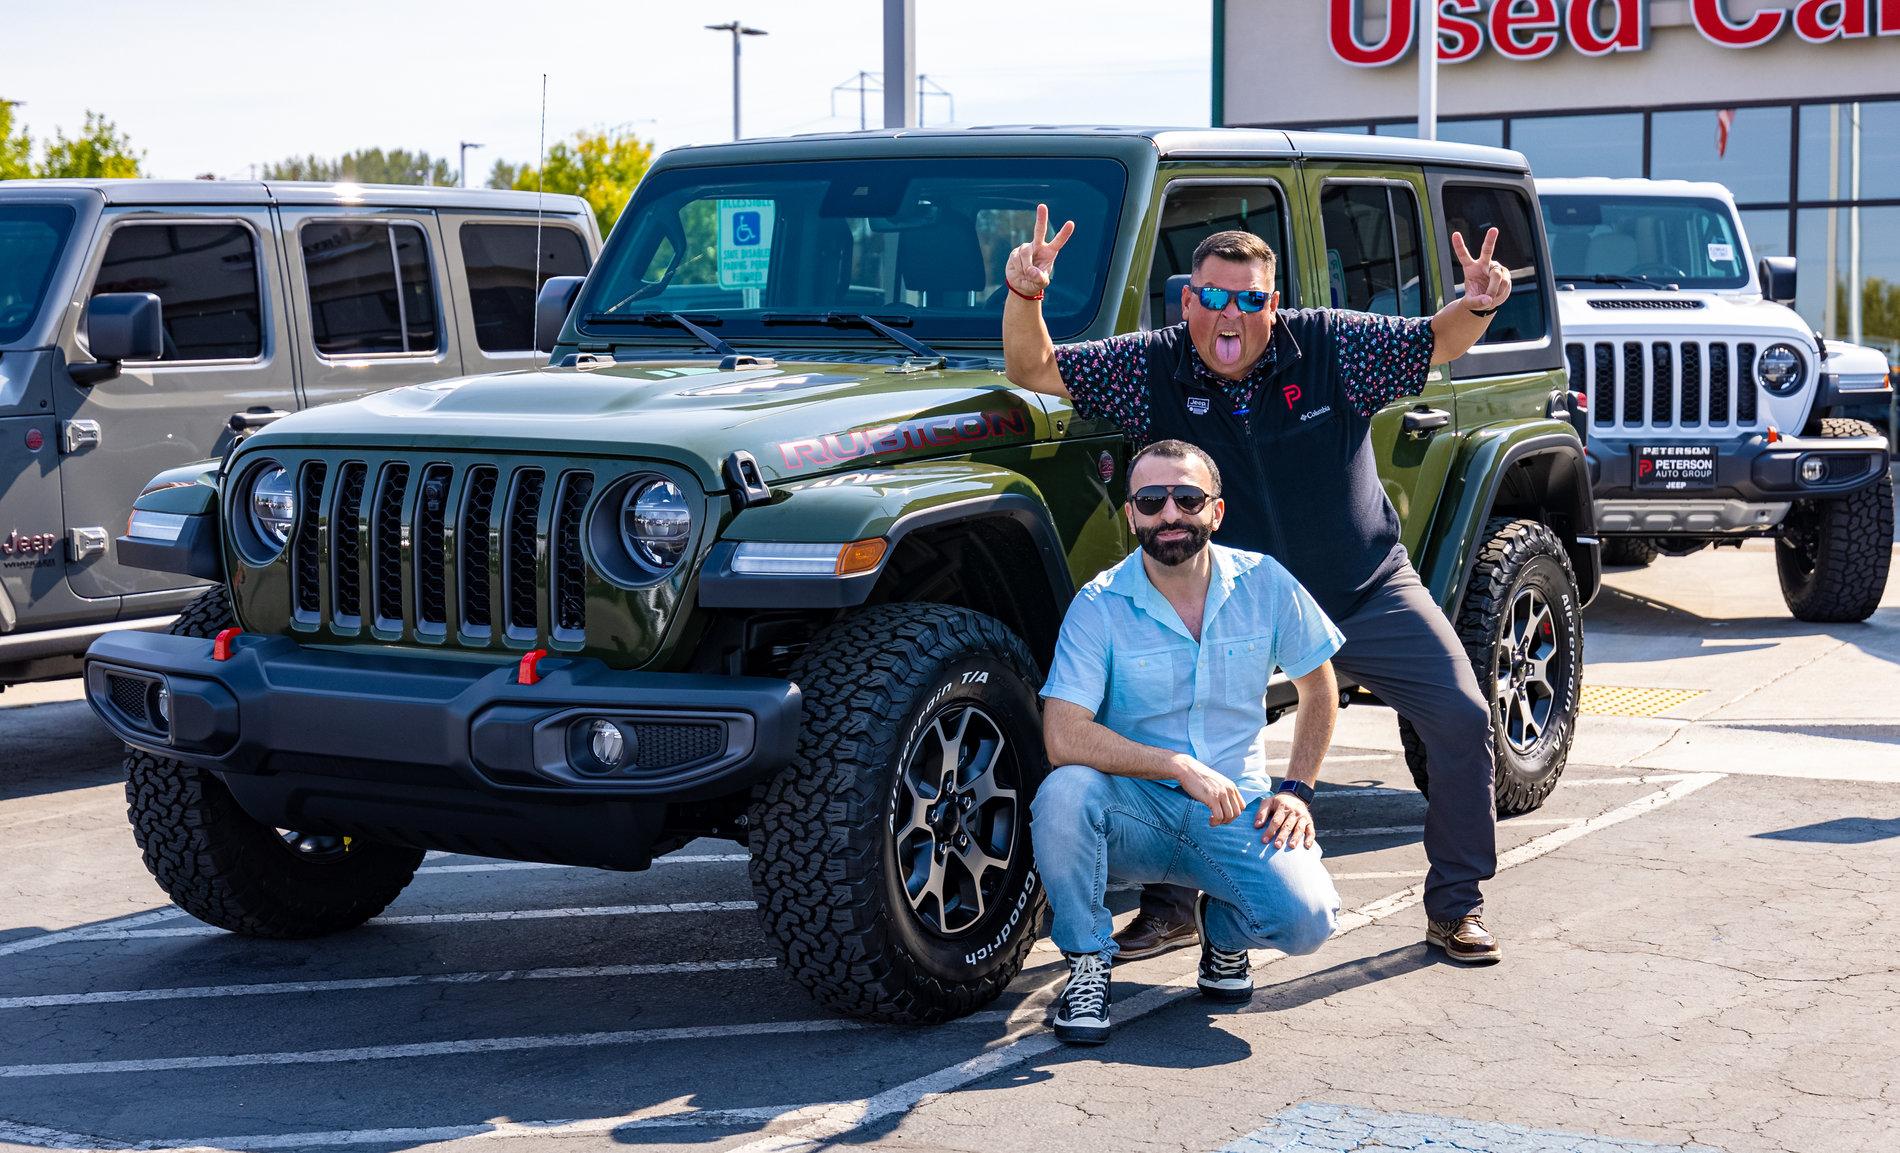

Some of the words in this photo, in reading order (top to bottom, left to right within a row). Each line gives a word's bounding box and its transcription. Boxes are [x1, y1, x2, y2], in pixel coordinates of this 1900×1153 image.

[1327, 0, 1645, 67] Used
[1689, 0, 1900, 49] Ca
[1190, 399, 1206, 407] Jeep
[1307, 405, 1331, 419] Columbia
[777, 408, 1028, 470] RUBICON
[1642, 447, 1710, 455] PETERSON
[1655, 460, 1712, 469] PETERSON
[1, 529, 56, 555] Jeep
[961, 670, 989, 684] T/A
[965, 859, 1037, 966] Goodrich
